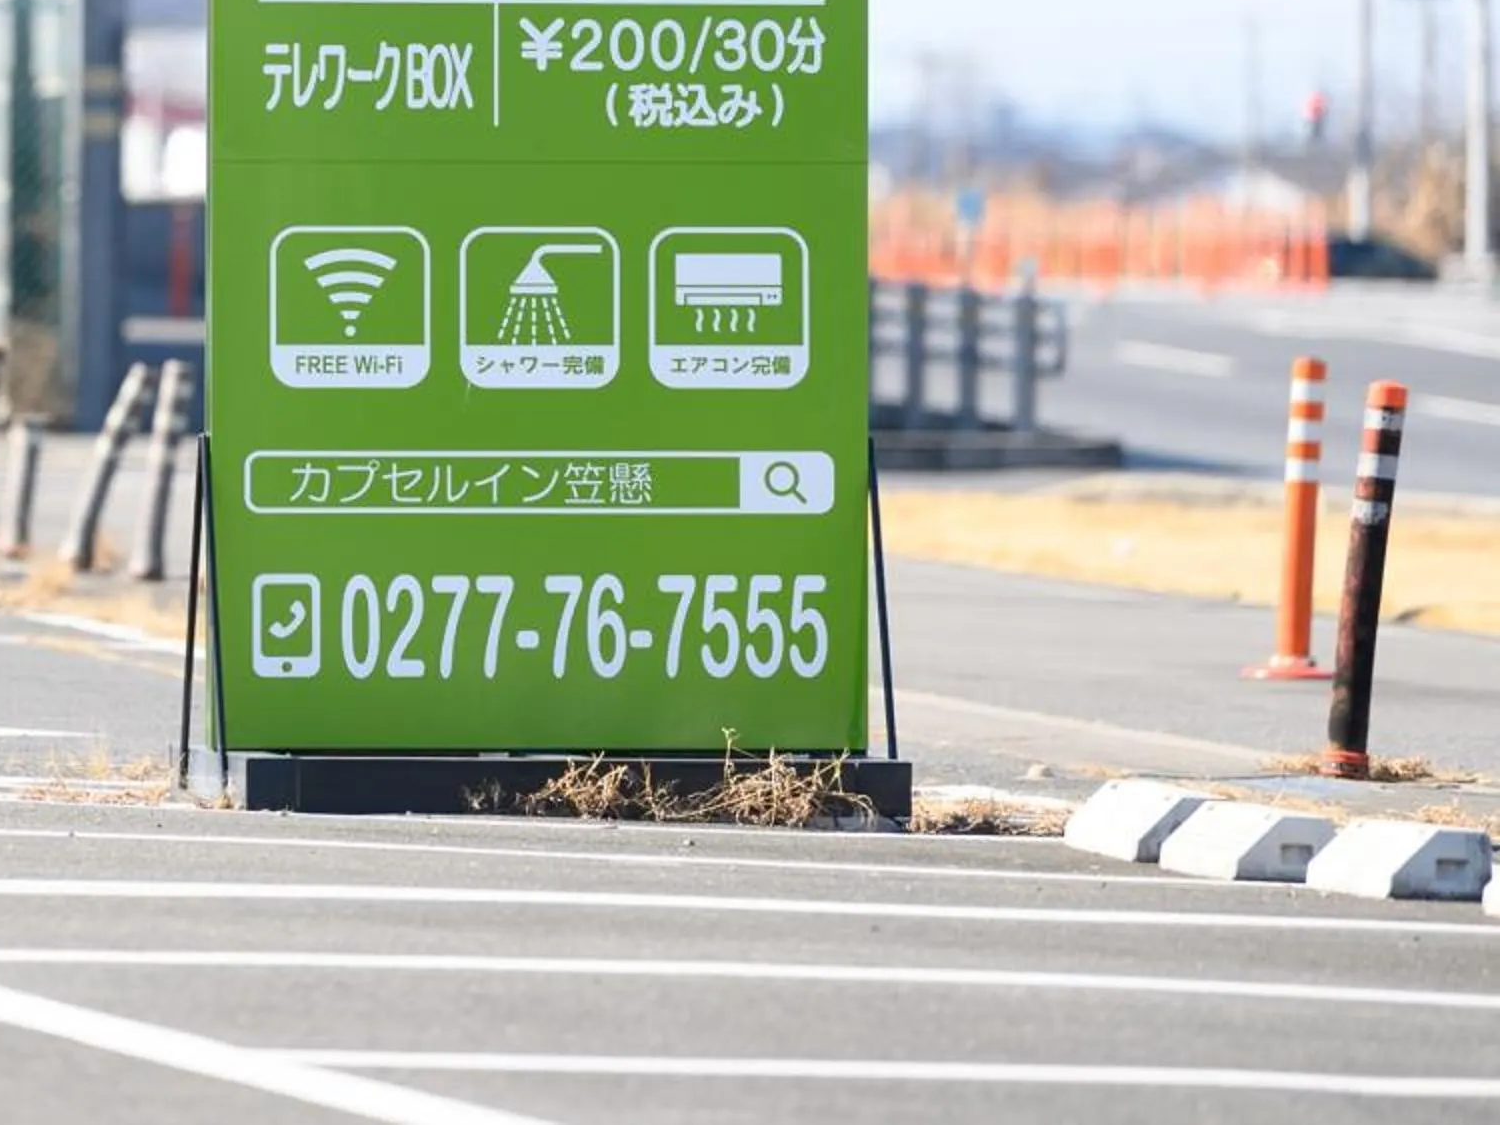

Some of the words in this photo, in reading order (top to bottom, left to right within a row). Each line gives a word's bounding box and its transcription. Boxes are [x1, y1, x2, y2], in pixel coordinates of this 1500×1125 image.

[520, 16, 827, 75] ¥200/30分
[262, 42, 475, 112] テレワークBOX
[295, 356, 347, 374] FREE
[354, 356, 403, 374] Wi-Fi
[476, 356, 605, 375] シャワー完備
[670, 356, 792, 375] エアコン完備
[289, 459, 653, 505] カプセルイン笠懸
[342, 574, 829, 680] 0277-76-7555
